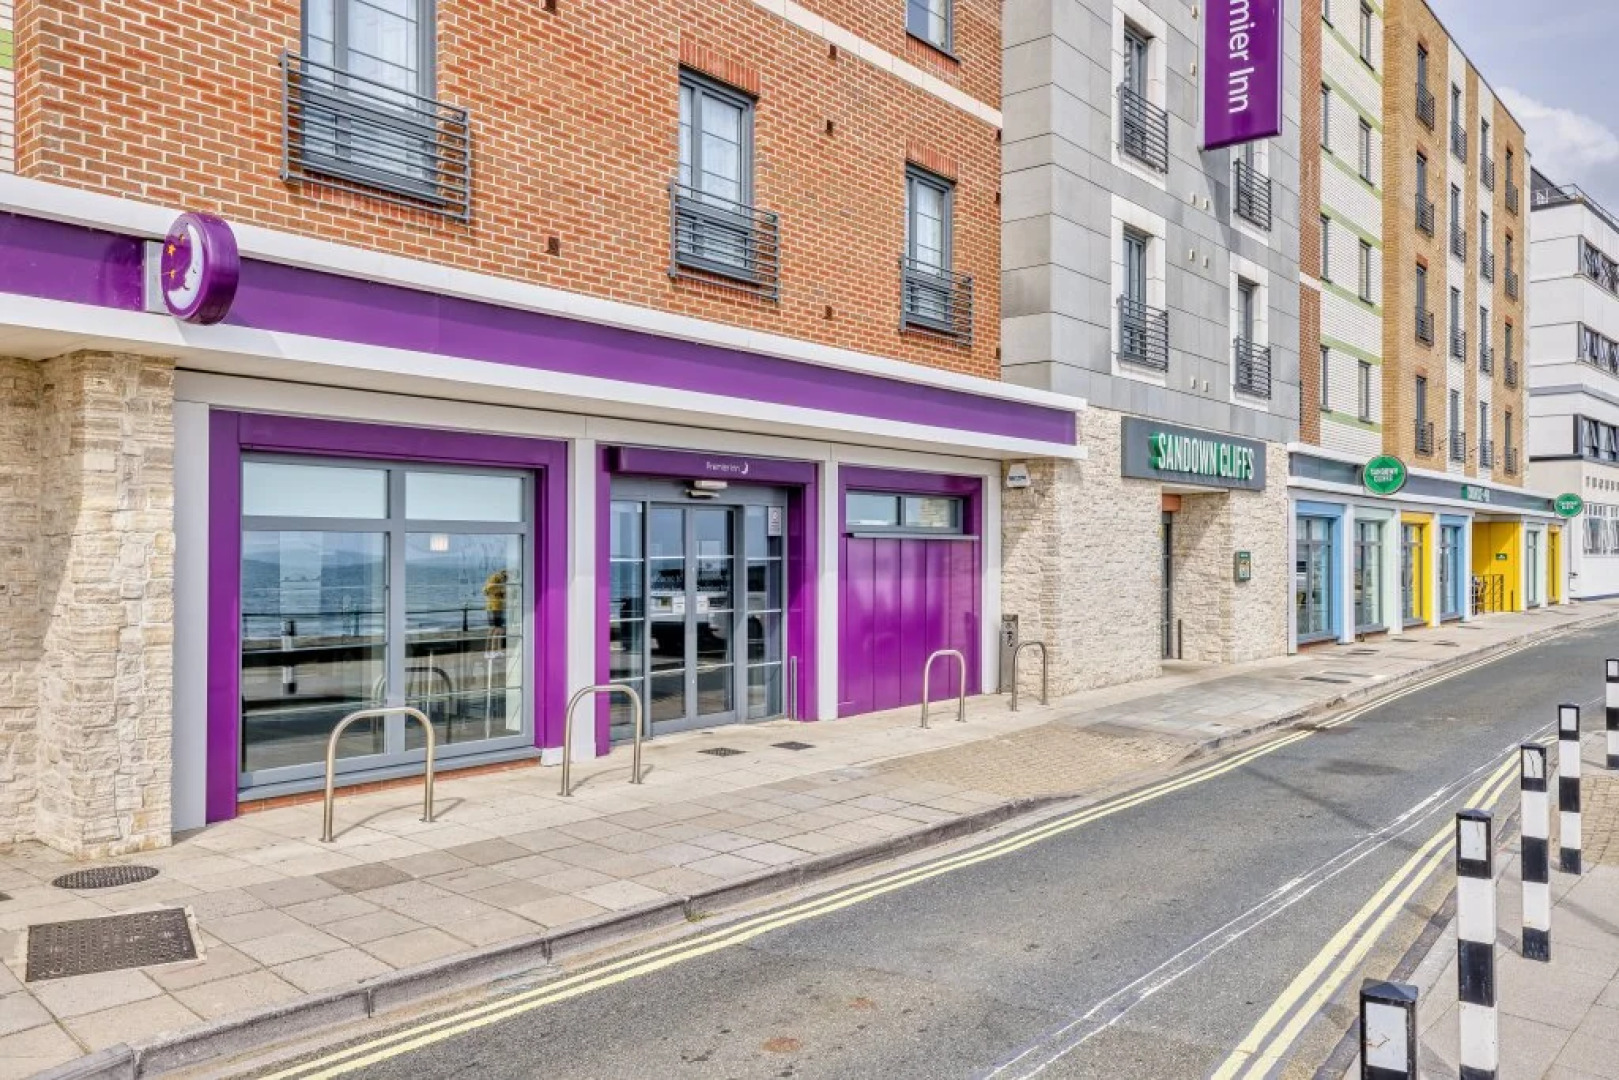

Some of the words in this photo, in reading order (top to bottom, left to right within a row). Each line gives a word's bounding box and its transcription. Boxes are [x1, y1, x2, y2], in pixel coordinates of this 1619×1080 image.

[1229, 67, 1255, 113] Inn
[1156, 432, 1217, 475] SANDOWN
[1220, 443, 1255, 480] CLIFFS
